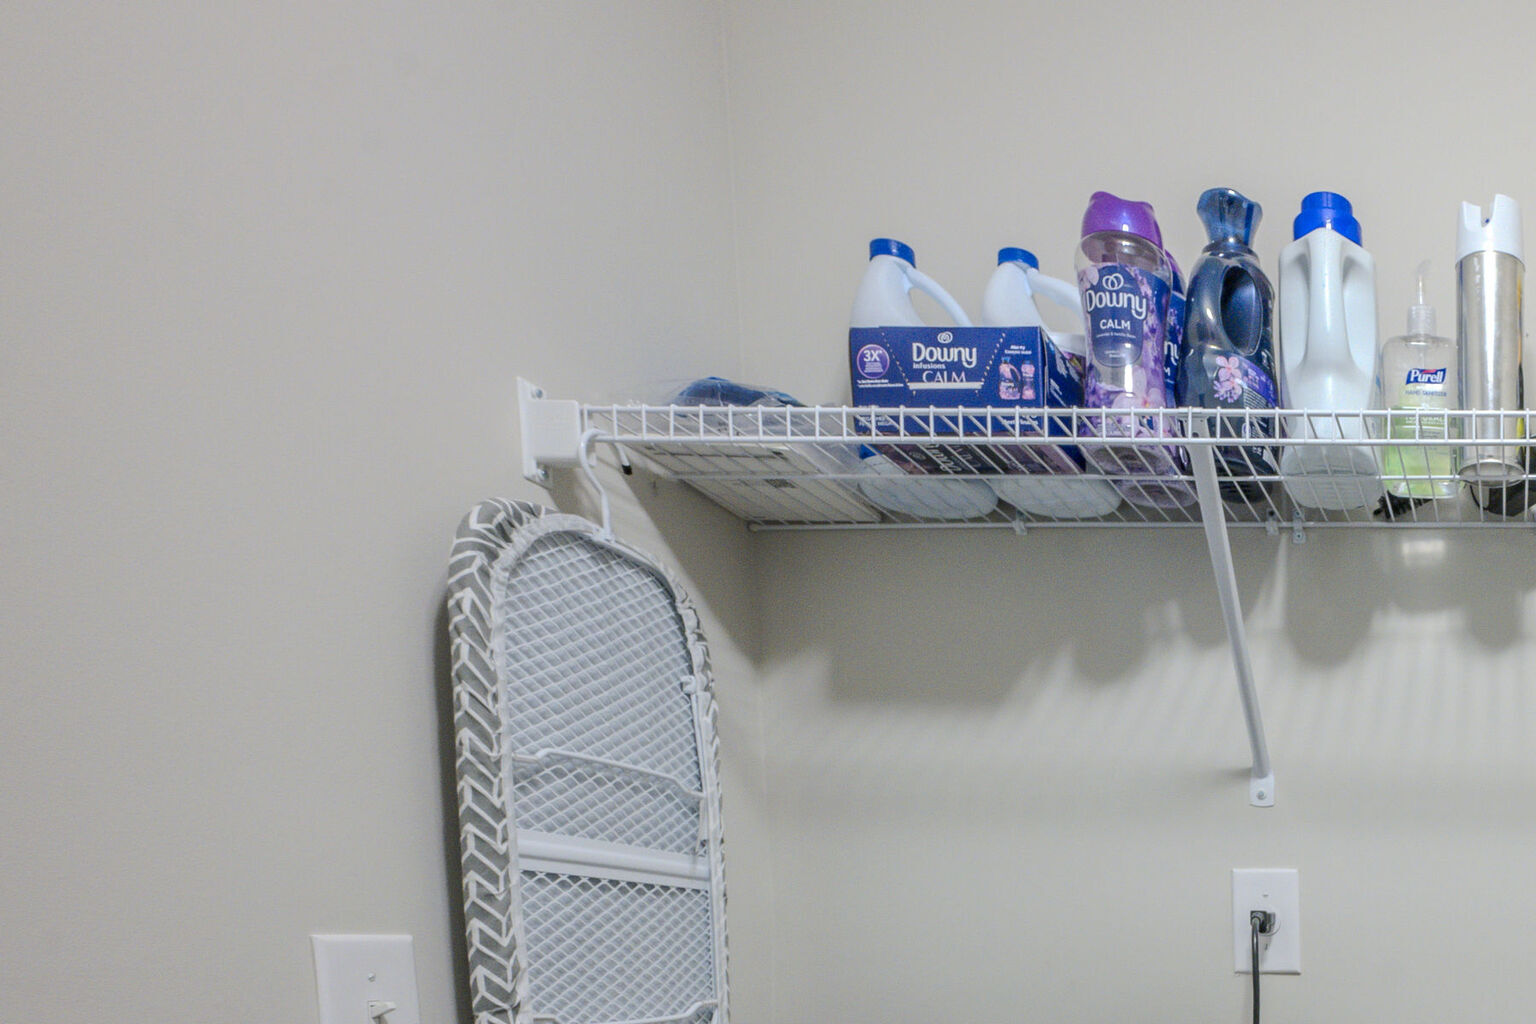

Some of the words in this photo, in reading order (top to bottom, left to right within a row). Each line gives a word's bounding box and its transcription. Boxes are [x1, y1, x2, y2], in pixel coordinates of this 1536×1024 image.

[1086, 290, 1147, 319] Downy
[1100, 320, 1130, 330] CALM
[912, 342, 978, 368] Downy
[1410, 370, 1444, 382] Purell
